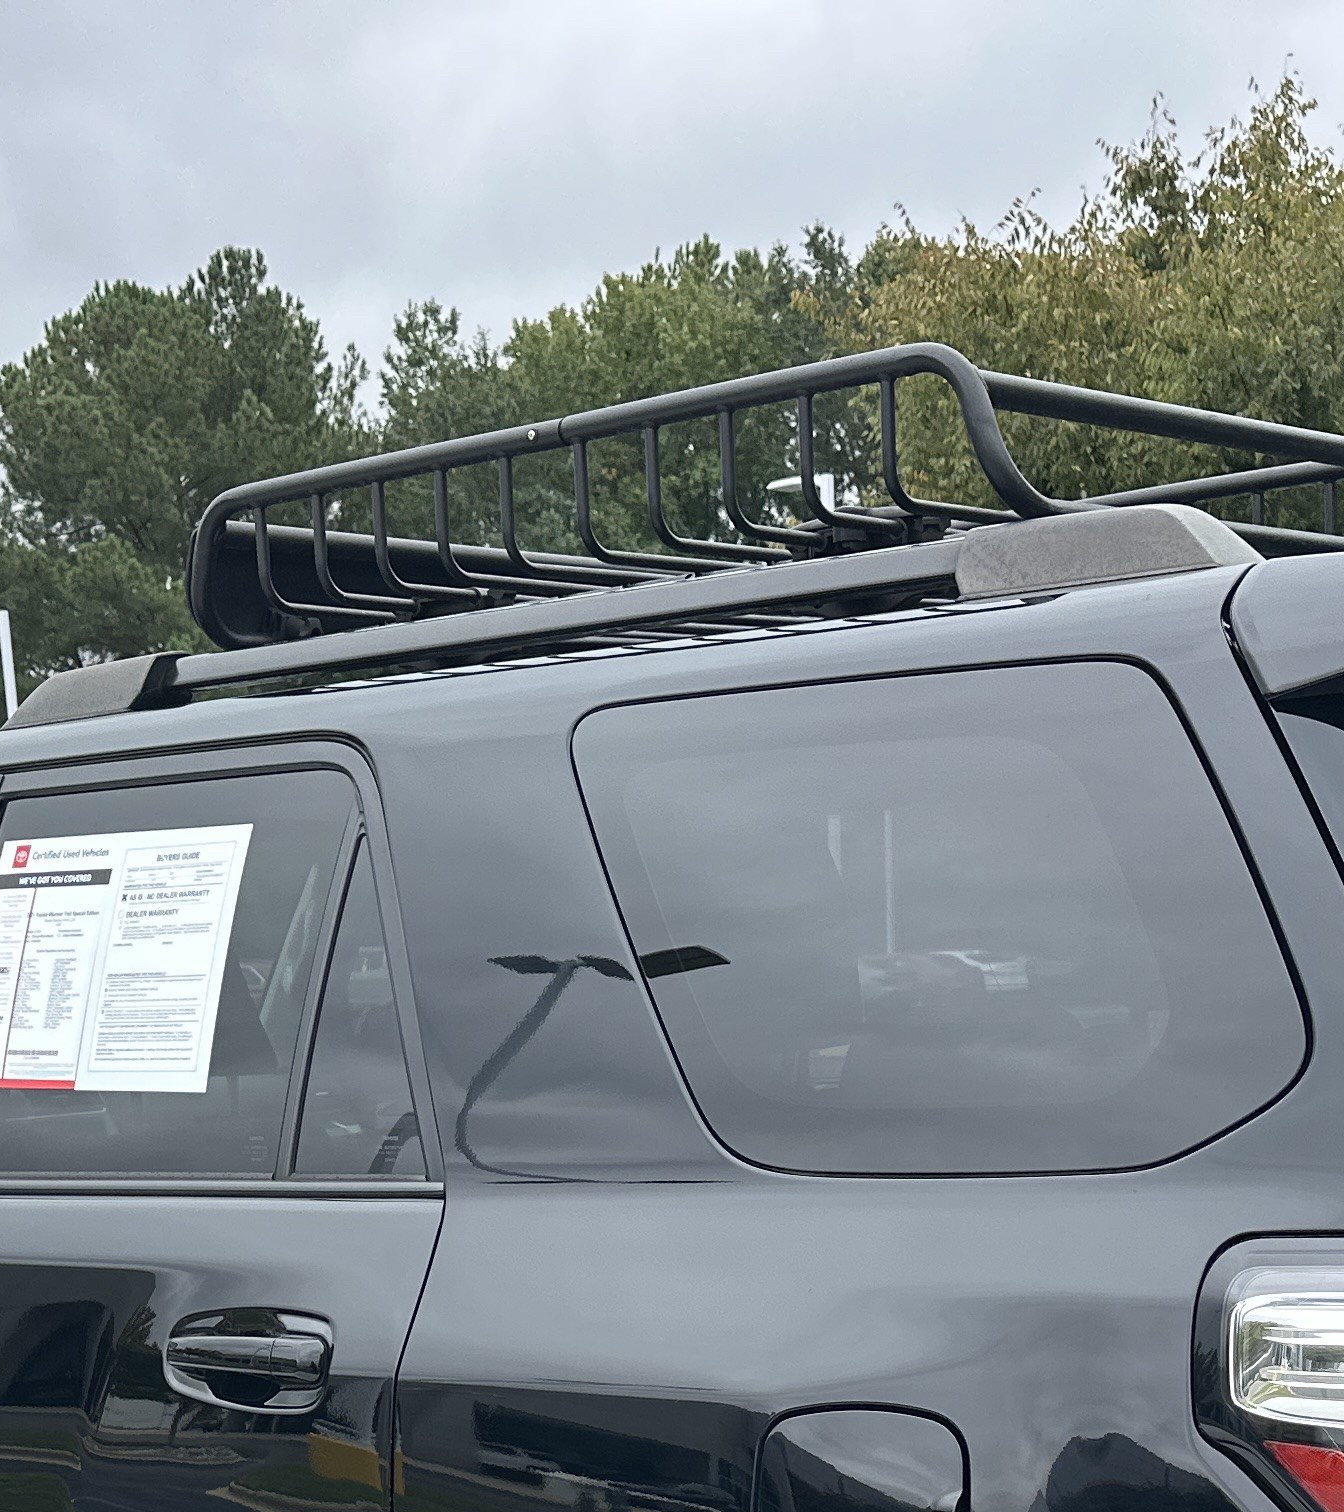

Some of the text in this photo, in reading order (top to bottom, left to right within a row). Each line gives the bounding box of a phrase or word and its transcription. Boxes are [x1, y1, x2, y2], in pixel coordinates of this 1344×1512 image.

[33, 848, 110, 860] Certified Used Vehicles
[157, 851, 201, 862] BUYERS GUIDE
[64, 874, 92, 883] COVERED
[156, 891, 177, 900] DEALER
[179, 890, 210, 898] WARRANTY
[126, 908, 179, 918] DEALER WARRANTY
